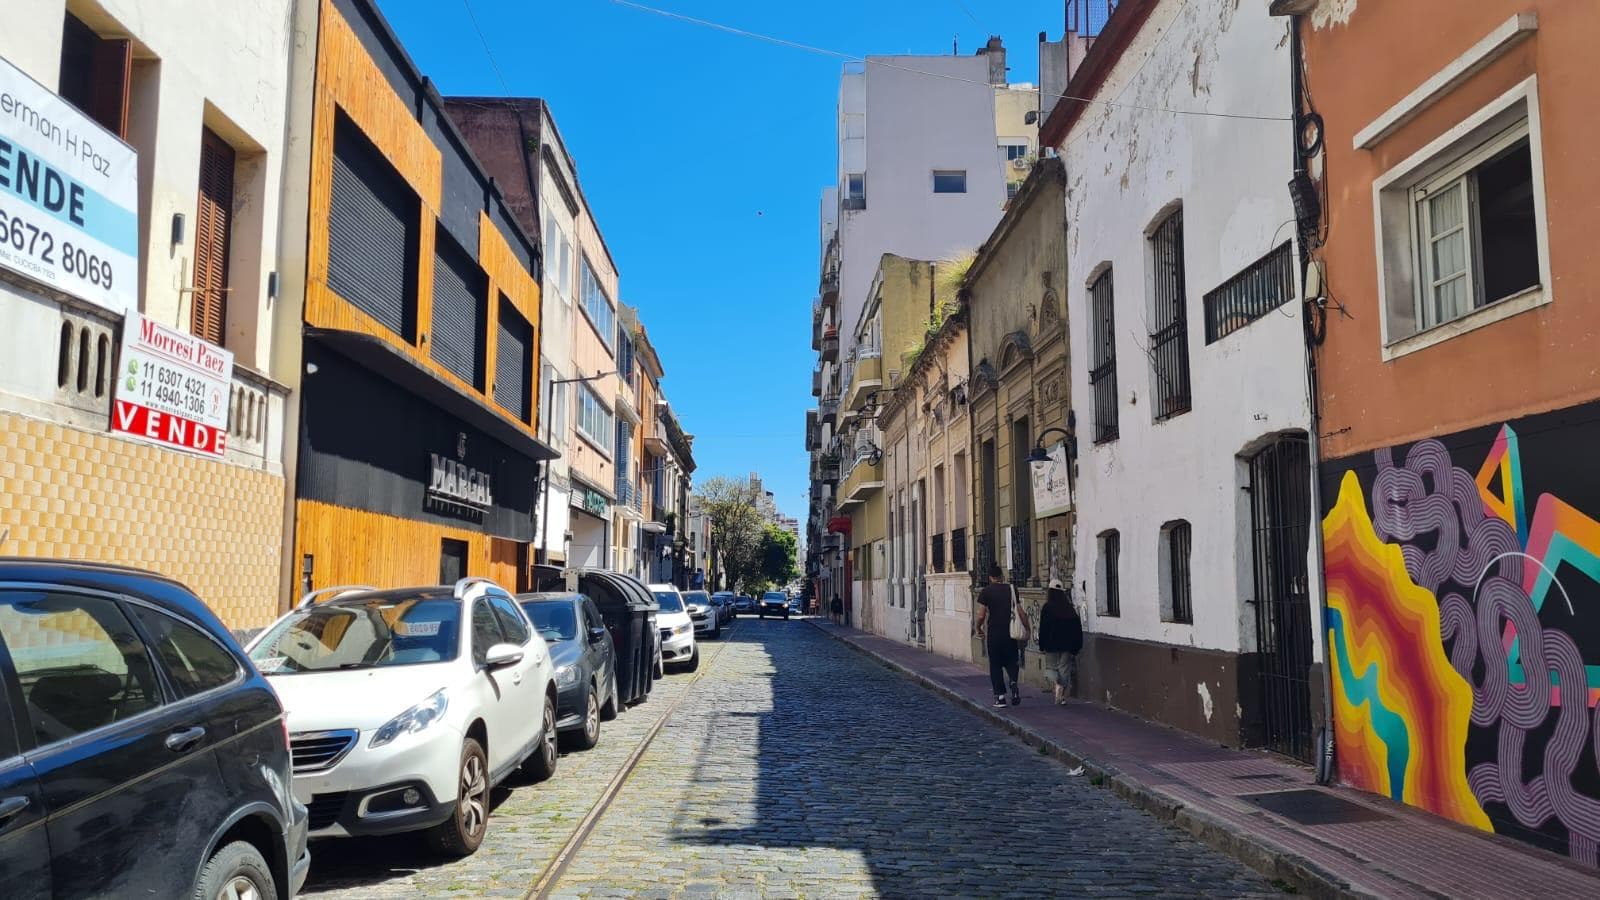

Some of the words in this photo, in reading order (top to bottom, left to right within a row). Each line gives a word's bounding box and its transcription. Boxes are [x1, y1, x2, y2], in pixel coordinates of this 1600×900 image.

[66, 128, 77, 157] H
[82, 140, 110, 178] Paz
[62, 242, 112, 290] 8069
[139, 318, 194, 361] Morresi
[197, 343, 224, 374] Paez
[140, 380, 152, 398] 11
[156, 385, 205, 415] 4940-1306
[143, 361, 155, 379] 11
[158, 366, 183, 389] 6307
[185, 376, 206, 398] 4321
[116, 401, 226, 455] VENDE
